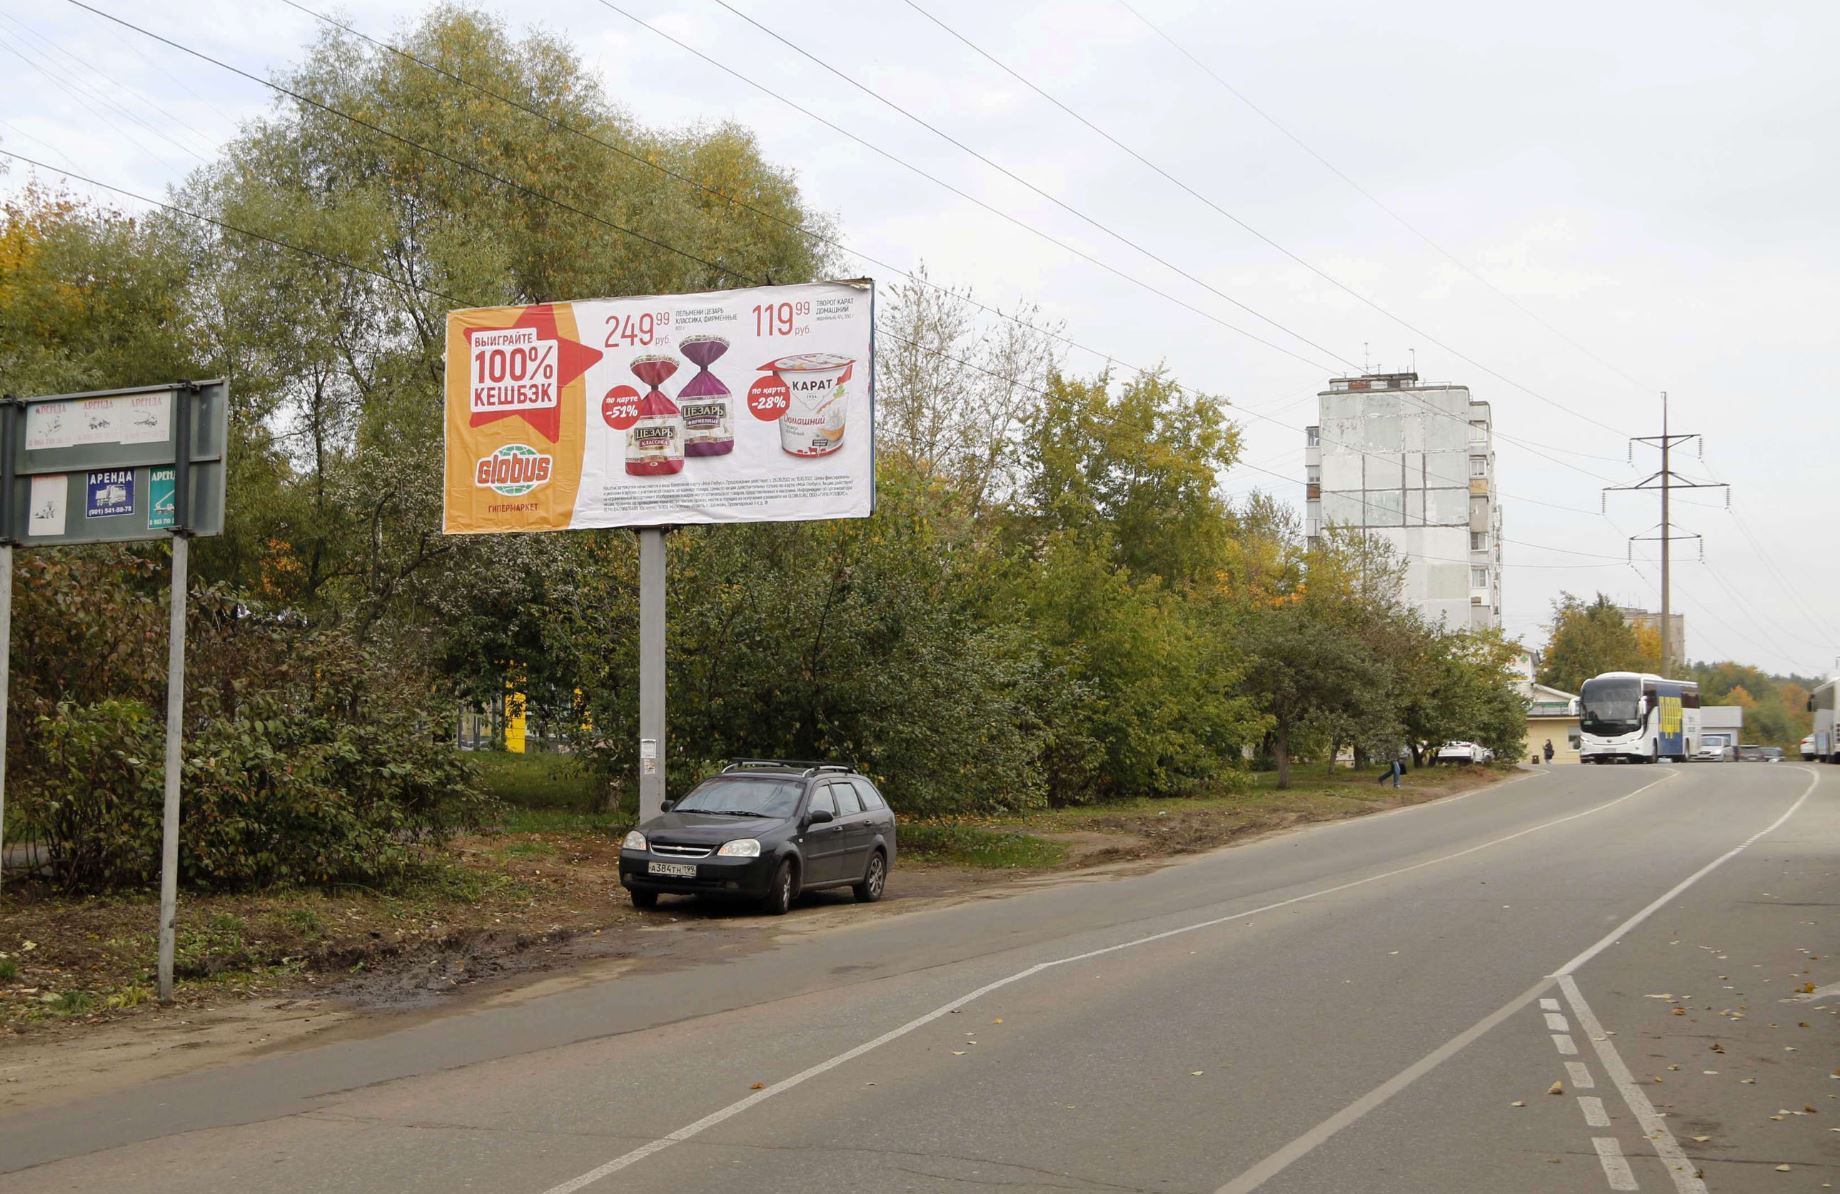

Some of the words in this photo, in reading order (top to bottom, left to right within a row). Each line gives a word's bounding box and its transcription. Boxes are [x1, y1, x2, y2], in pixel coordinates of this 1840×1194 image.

[704, 307, 724, 315] ЦЕЗАРЬ
[816, 306, 849, 315] ДОМАШНИЙ
[752, 302, 793, 337] 119
[795, 301, 810, 315] 99
[604, 313, 654, 348] 249
[655, 311, 670, 326] 99
[474, 333, 533, 348] ВЫИГРАЙТЕ
[474, 346, 554, 384] 100%
[792, 379, 833, 391] КАРАТ
[474, 383, 553, 407] КЕШБЭК
[751, 396, 786, 409] -28%
[606, 406, 638, 418] -51%
[682, 405, 724, 417] ЦЕЗАРЬ
[635, 427, 674, 439] ЦЕЗАРЬ
[90, 471, 132, 485] АРЕНДА
[488, 502, 539, 513] ГИПЕРМАРКЕТ
